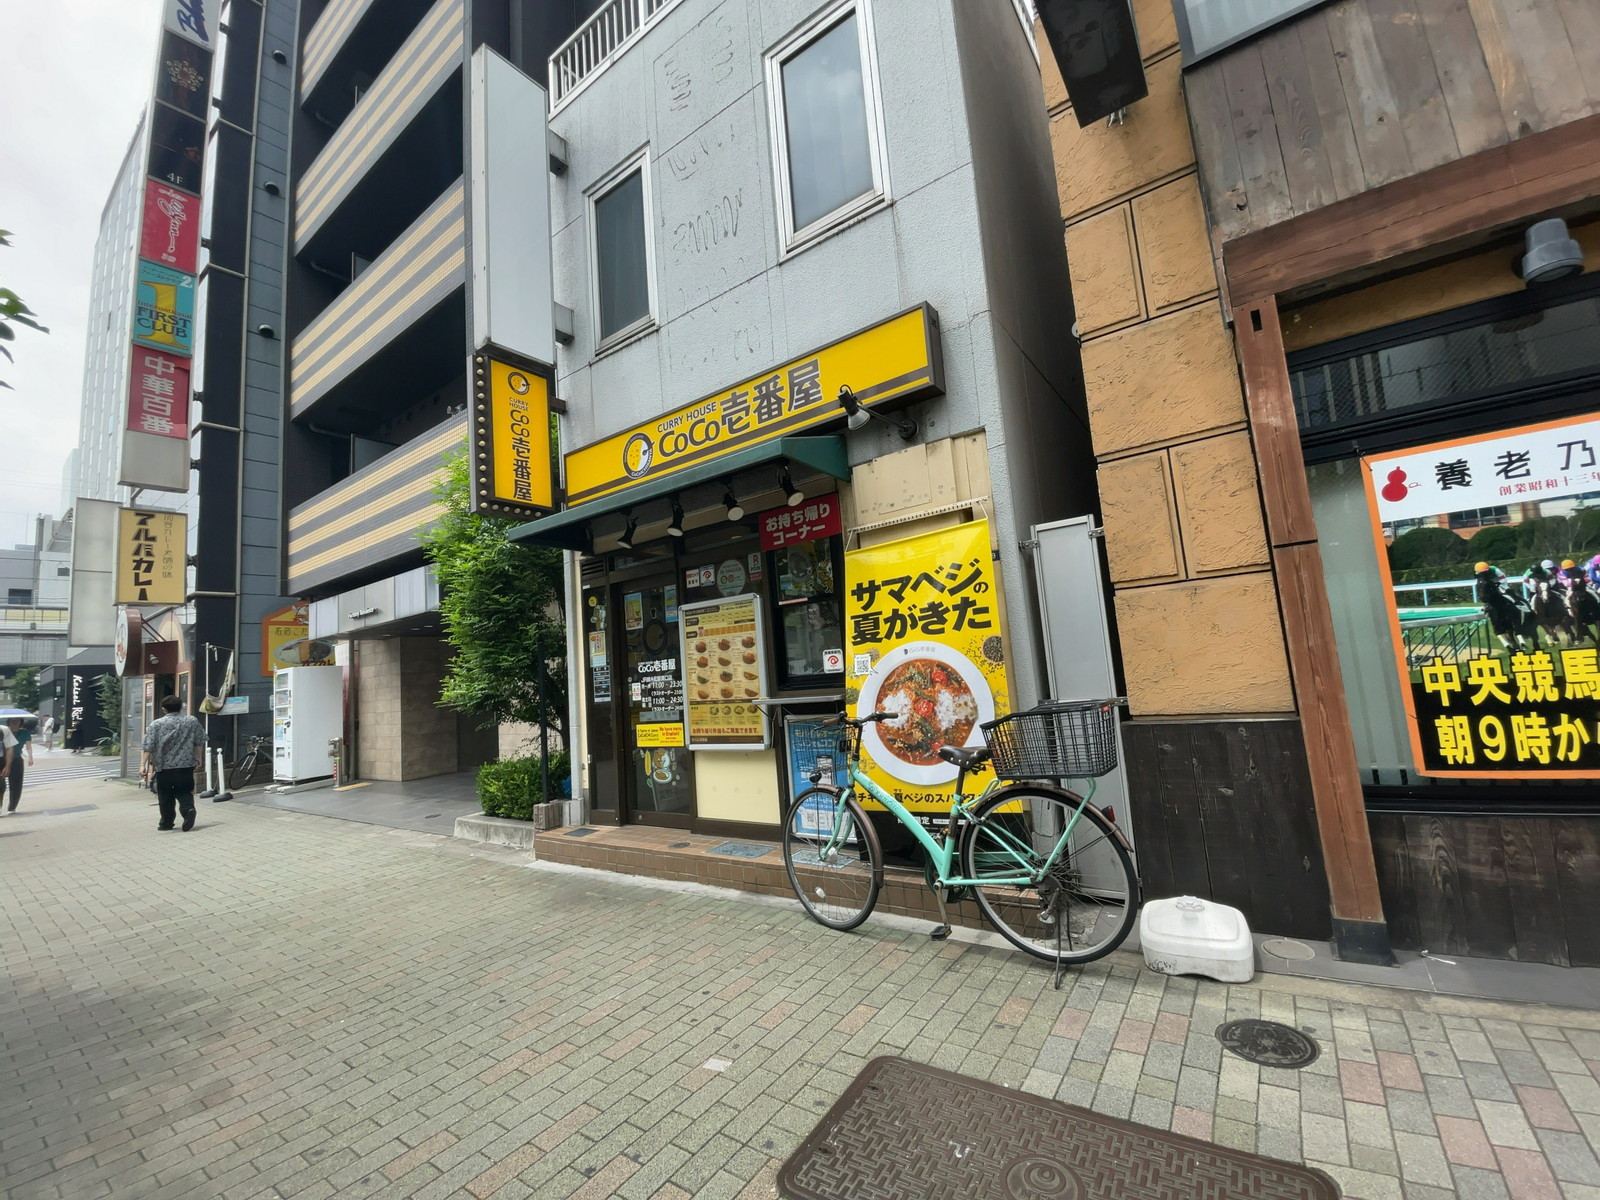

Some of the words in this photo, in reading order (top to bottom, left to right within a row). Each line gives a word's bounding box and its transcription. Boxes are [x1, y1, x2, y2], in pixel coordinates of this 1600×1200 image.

[137, 306, 192, 329] FIRST
[137, 317, 188, 338] CLUB
[140, 355, 176, 434] 中華百番
[509, 396, 529, 407] CURRY
[509, 402, 529, 412] HOUSE
[658, 358, 823, 459] CoCo壱番屋
[656, 412, 686, 433] CURRY
[685, 401, 717, 422] HOUSE
[1434, 439, 1597, 491] 養老乃
[765, 502, 831, 533] お持ち帰り
[772, 523, 826, 546] コーナー
[850, 557, 989, 612] サマベジの
[850, 596, 993, 647] 夏がきた
[1421, 648, 1600, 708] 中央競馬
[1434, 711, 1600, 765] 朝9時か
